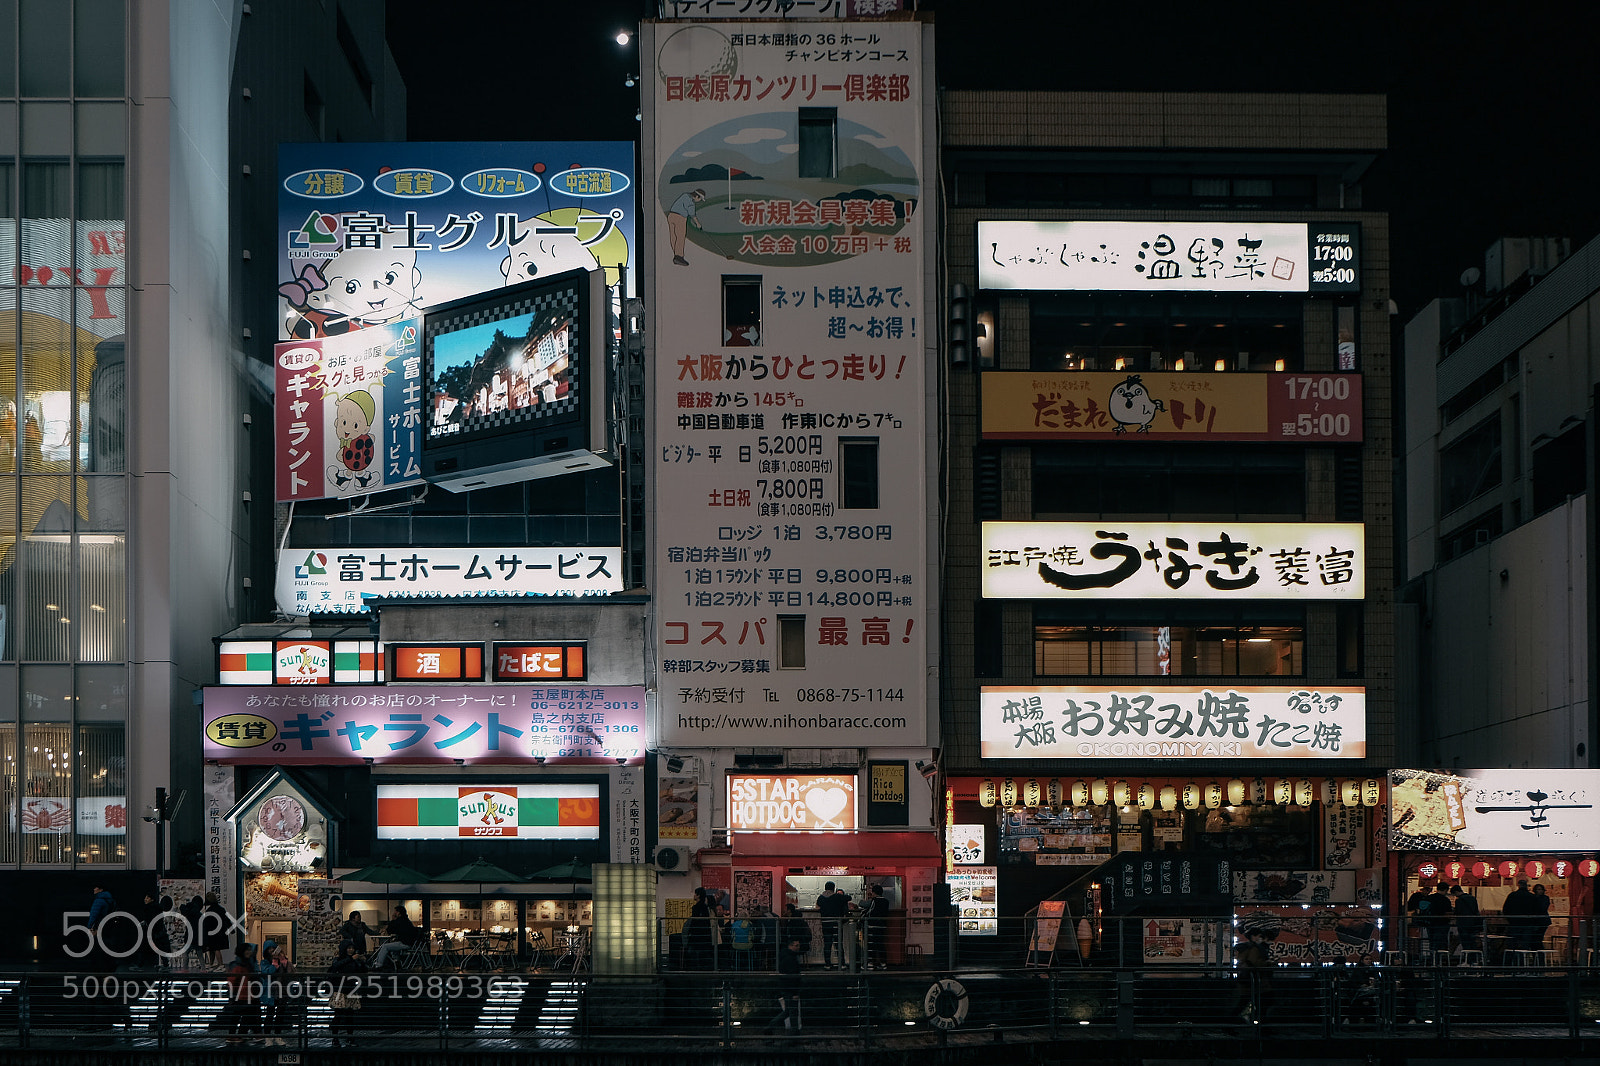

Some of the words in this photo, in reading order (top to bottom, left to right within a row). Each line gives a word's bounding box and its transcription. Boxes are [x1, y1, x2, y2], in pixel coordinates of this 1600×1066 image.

[731, 33, 811, 46] 西日本屈指の
[816, 35, 836, 46] 36
[840, 33, 880, 46] ホール
[785, 49, 909, 62] チャンピオンコース
[666, 74, 910, 102] 日本原カンツリー倶楽部
[304, 172, 345, 195] 分譲
[394, 172, 434, 195] 賃貸
[477, 173, 525, 193] リフォーム
[566, 171, 613, 193] 中古流通
[340, 208, 624, 251] 富士グループ
[1316, 233, 1350, 243] 営業時間
[312, 251, 339, 259] Group
[742, 236, 797, 254] 入会金
[991, 242, 1121, 268] しゃぶしゃぶ
[1313, 245, 1353, 262] 17:00
[1135, 232, 1267, 281] 温野菜
[1313, 268, 1355, 284] 翌5:00
[283, 350, 315, 367] 賃貸の
[1284, 377, 1350, 401] 17:00
[402, 356, 423, 480] 富士ホーム
[677, 413, 765, 431] 中国自動車道
[1032, 393, 1108, 429] だまれ
[1170, 399, 1217, 432] トリ
[286, 372, 312, 496] ギャラント
[1282, 412, 1351, 437] 翌5:00
[388, 413, 401, 477] サービス
[757, 435, 822, 456] 5,200円
[708, 489, 751, 507] 土日祝
[756, 478, 823, 500] 7,800円
[718, 525, 762, 542] ロッジ
[773, 525, 801, 541] 1泊
[815, 525, 892, 541] 3,780円
[668, 546, 772, 563] 宿泊弁当パック
[988, 544, 1084, 568] 江戸焼
[1038, 530, 1264, 591] うなぎ
[337, 552, 612, 583] 富士ホームサービス
[767, 568, 802, 585] 平日
[1270, 546, 1354, 587] 菱富
[296, 603, 356, 613] なんさん支店
[767, 591, 802, 607] 平日
[665, 617, 767, 645] コスパ
[416, 652, 441, 674] 酒
[500, 651, 562, 674] たばこ
[664, 659, 770, 674] 幹部スタッフ募集
[531, 689, 605, 700] 玉屋町本店
[677, 687, 745, 704] 予約受付
[797, 688, 904, 702] 0868-75-1144
[530, 701, 640, 711] 06-6212-3013
[1001, 696, 1045, 724] 本場
[1061, 692, 1250, 740] お好み焼
[530, 725, 640, 733] 06-6765-1306
[531, 712, 605, 724] 島之内支店
[678, 713, 906, 731] http://www.nihonbaracc.com
[217, 721, 268, 741] 賃貸
[279, 711, 524, 752] ギャラント
[1014, 720, 1056, 749] 大阪
[1256, 713, 1343, 753] たこ焼
[272, 741, 287, 753] の
[1076, 741, 1242, 757] OKONOMIYAKI
[731, 778, 800, 801] 5STAR
[873, 777, 893, 789] Rice
[1367, 780, 1377, 804] 日本酒
[873, 789, 904, 802] Hotdog
[731, 801, 806, 823] HOTDOG
[209, 798, 220, 873] 大阪下町の時計台
[474, 827, 504, 836] サンクス
